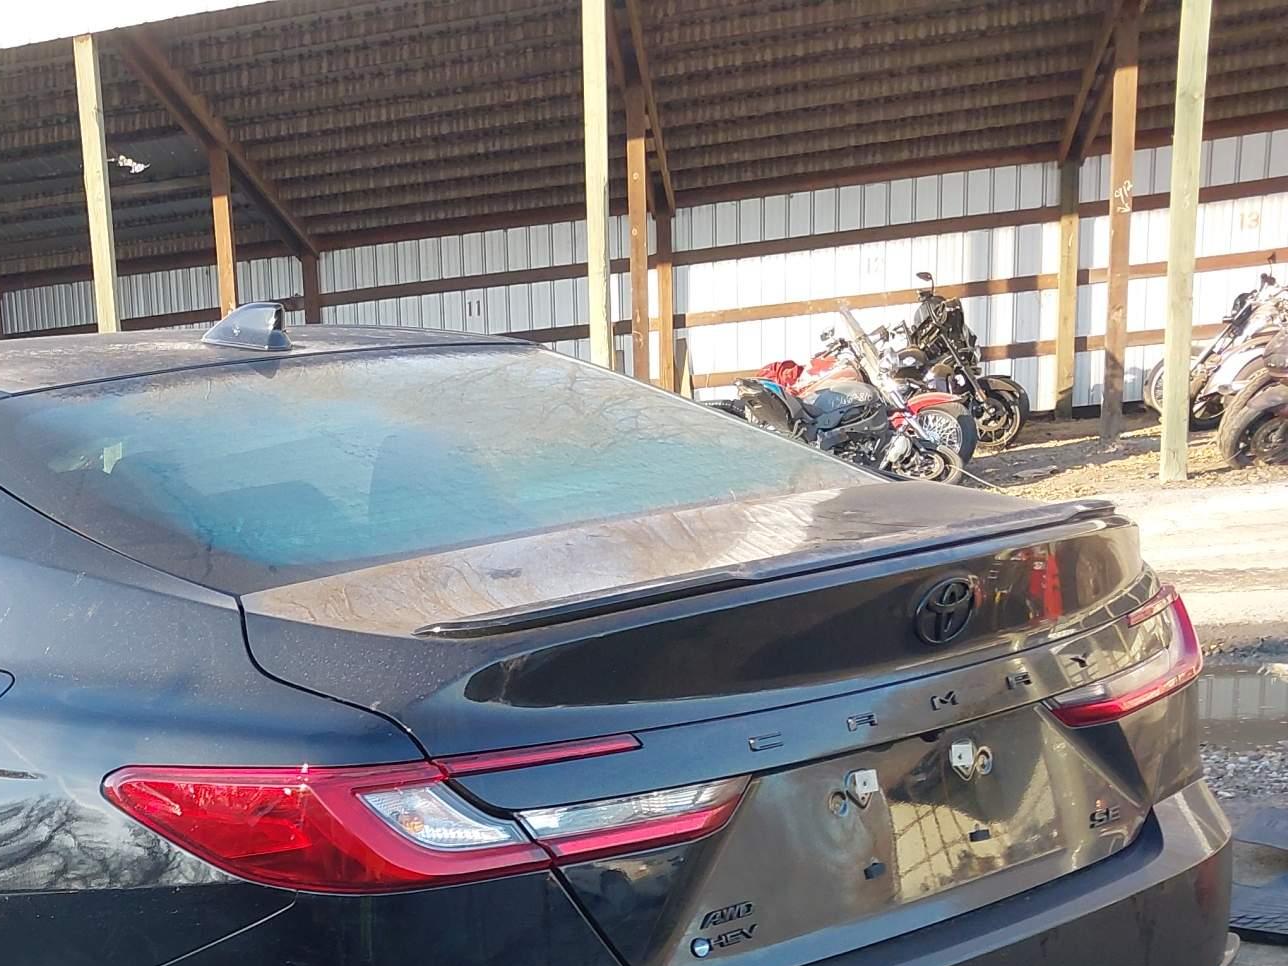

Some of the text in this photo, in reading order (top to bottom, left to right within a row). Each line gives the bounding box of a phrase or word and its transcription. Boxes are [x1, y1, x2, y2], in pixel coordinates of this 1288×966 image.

[466, 299, 481, 317] 11
[747, 652, 1090, 751] CAMRY
[1088, 806, 1121, 829] SE
[699, 901, 754, 930] AWD
[712, 924, 759, 947] HEV
